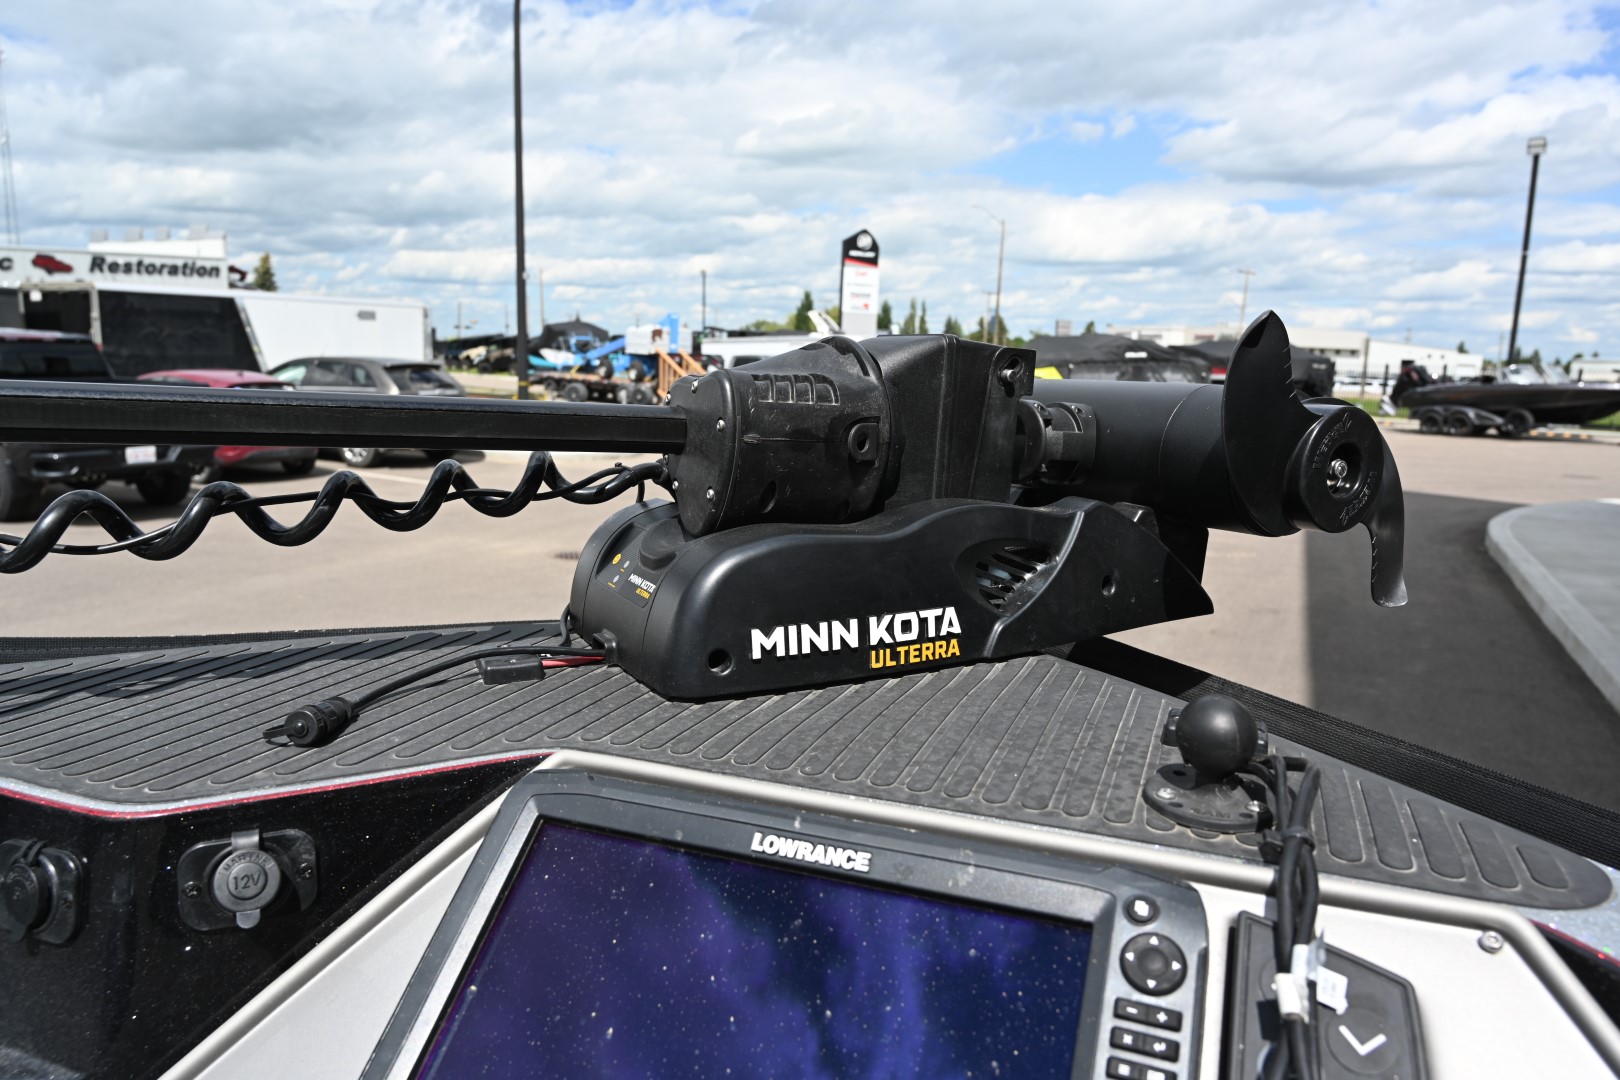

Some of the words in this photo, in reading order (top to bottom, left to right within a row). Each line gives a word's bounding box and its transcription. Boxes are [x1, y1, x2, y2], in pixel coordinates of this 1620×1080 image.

[90, 255, 220, 278] Restoration
[640, 580, 656, 593] KOTA
[751, 618, 859, 660] MINN
[869, 606, 962, 646] KOTA
[871, 638, 961, 669] ULTERRA
[223, 853, 269, 872] MARINE
[750, 831, 872, 873] LOWRANCE
[233, 872, 262, 891] 12V
